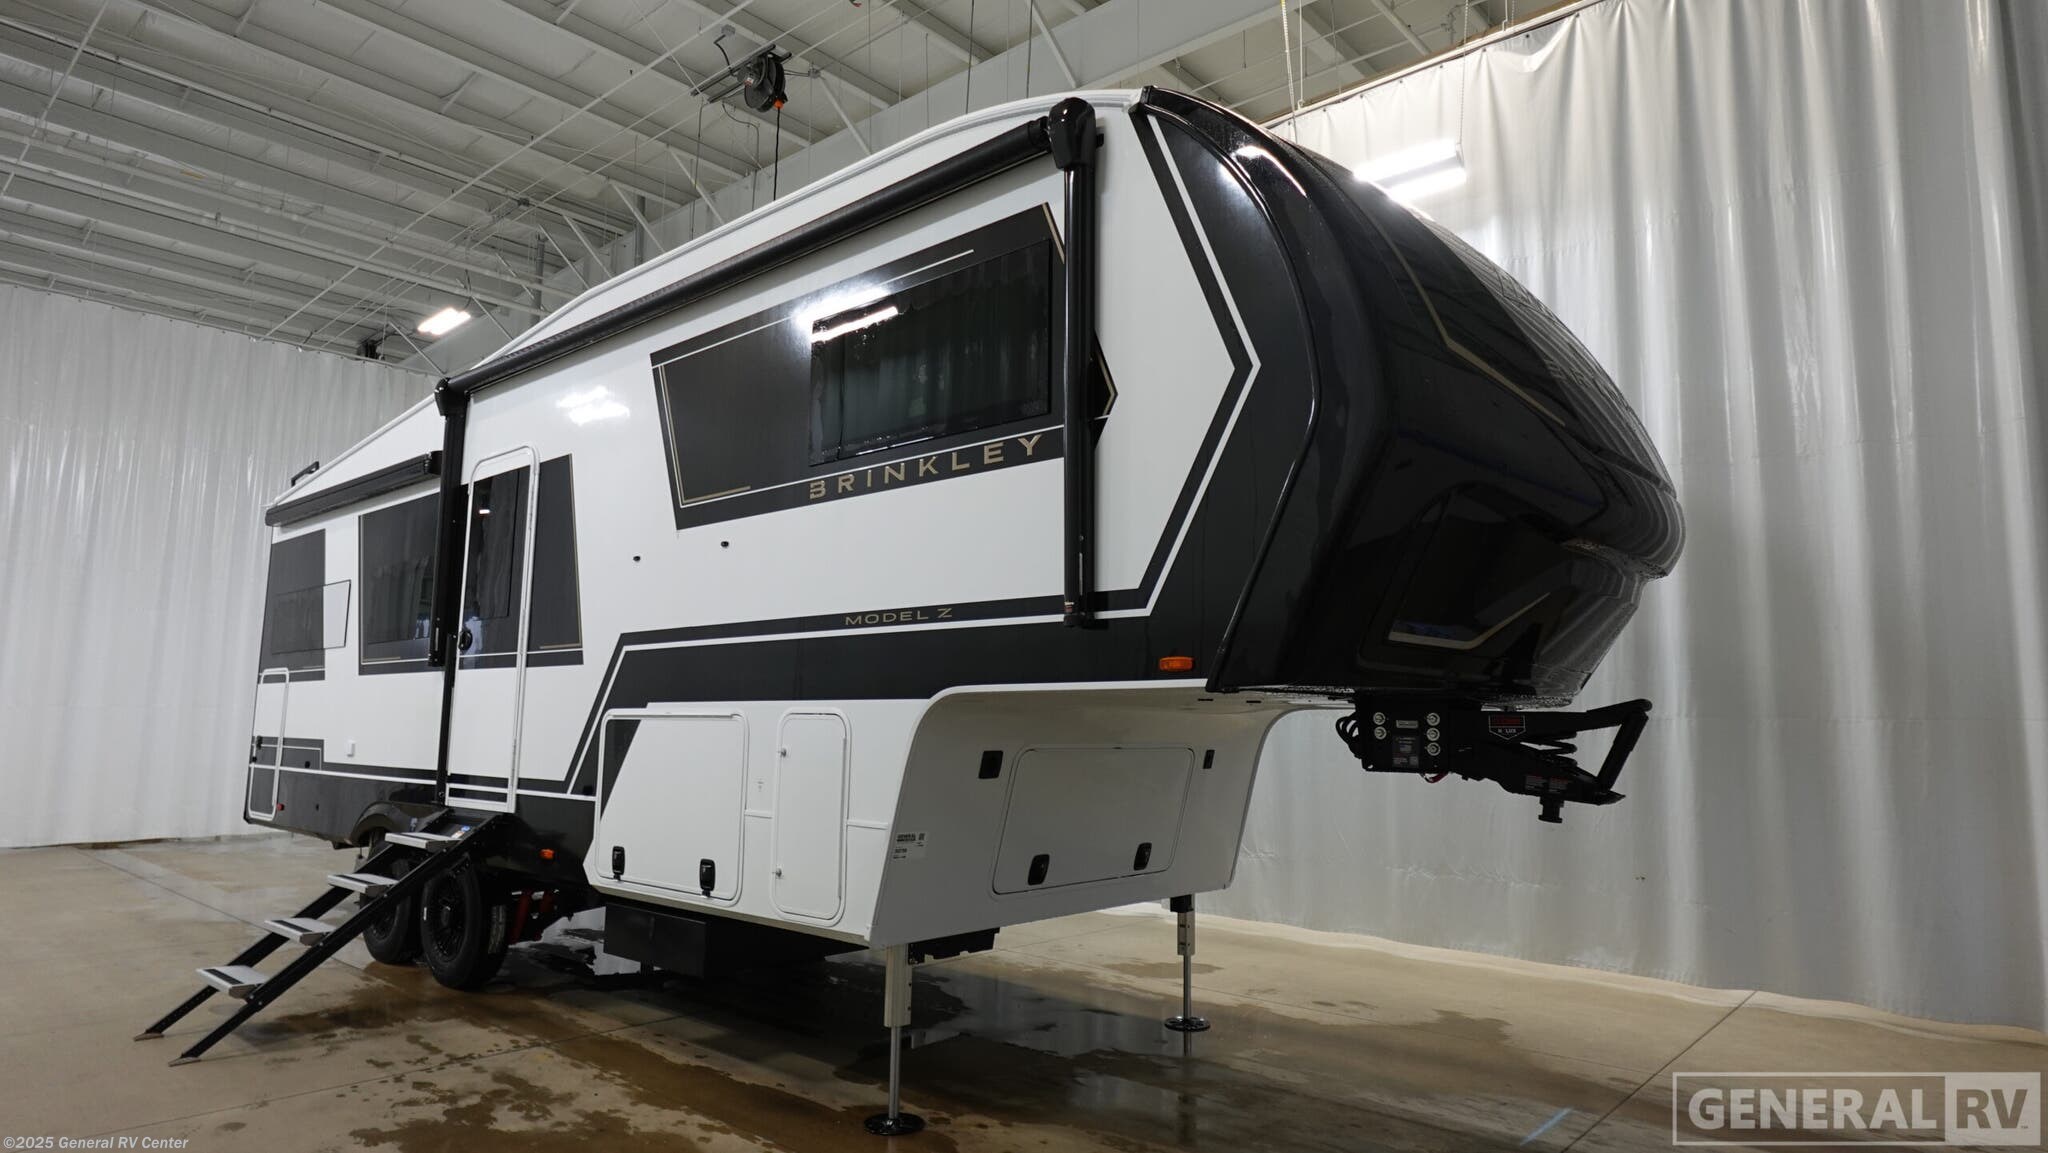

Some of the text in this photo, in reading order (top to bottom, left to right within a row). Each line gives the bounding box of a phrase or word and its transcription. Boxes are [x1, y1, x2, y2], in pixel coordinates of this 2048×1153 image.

[809, 434, 1043, 500] BRINKLEY
[845, 607, 952, 626] MODEL Z
